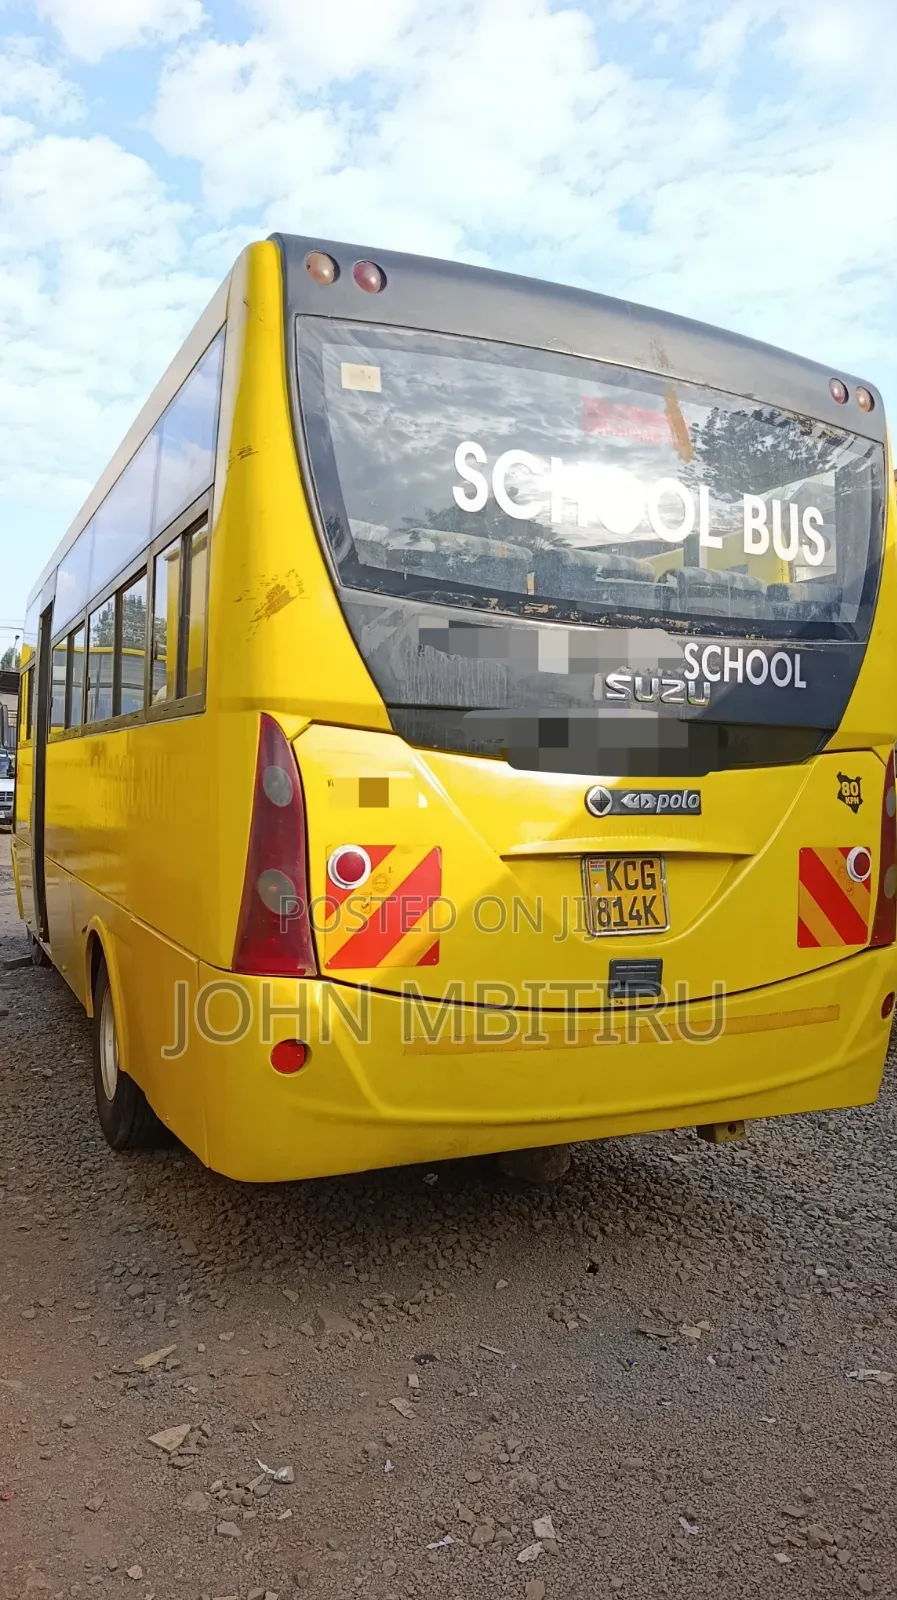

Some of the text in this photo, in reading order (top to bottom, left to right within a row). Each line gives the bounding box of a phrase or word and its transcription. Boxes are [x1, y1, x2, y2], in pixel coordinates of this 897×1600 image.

[452, 441, 826, 567] SCHOOL BUS
[684, 642, 807, 689] SCHOOL
[841, 781, 860, 797] 80
[605, 859, 657, 892] KCG
[597, 895, 660, 928] 814K
